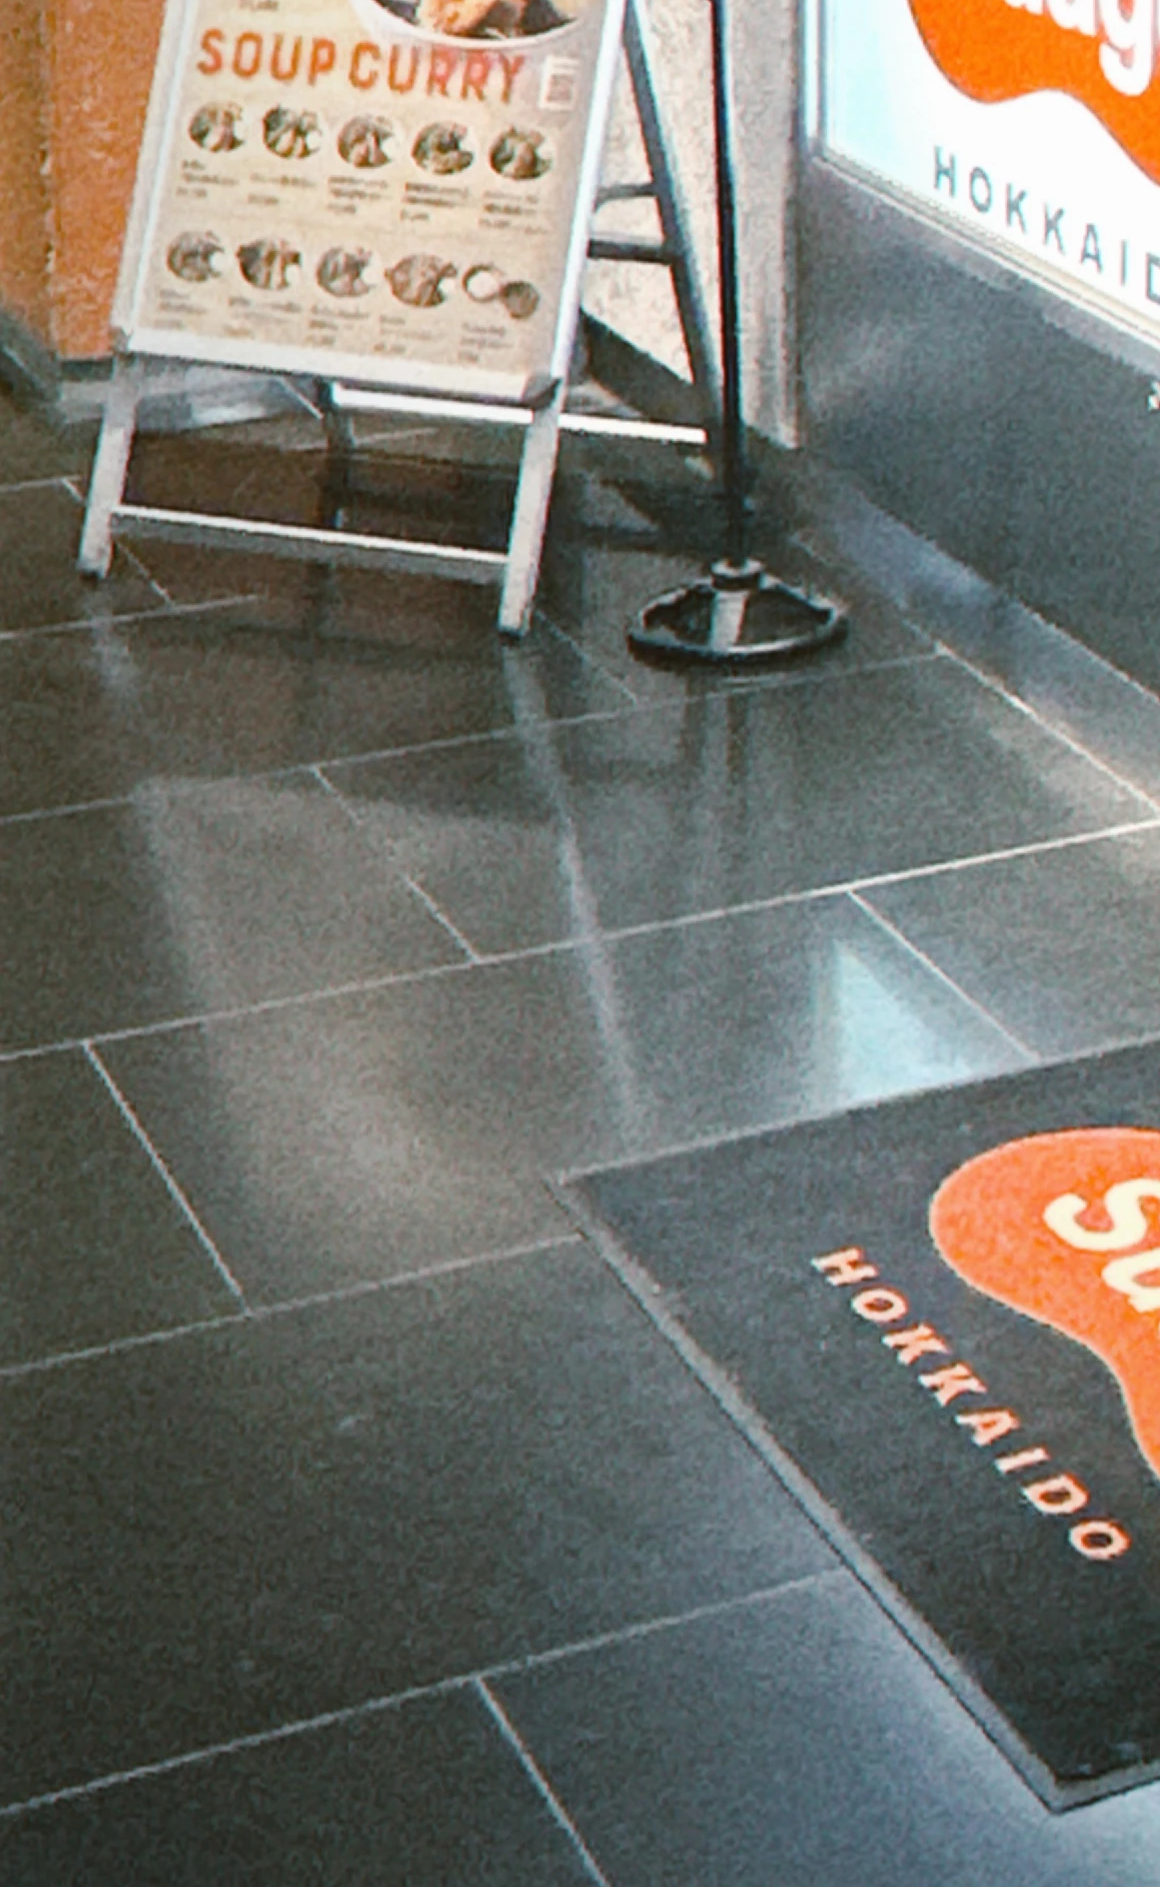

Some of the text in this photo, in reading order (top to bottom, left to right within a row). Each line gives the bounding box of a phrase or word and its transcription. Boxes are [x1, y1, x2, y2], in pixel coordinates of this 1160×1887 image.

[198, 27, 526, 105] SOUP CURRY
[810, 1245, 1132, 1562] HOKKAIDO
